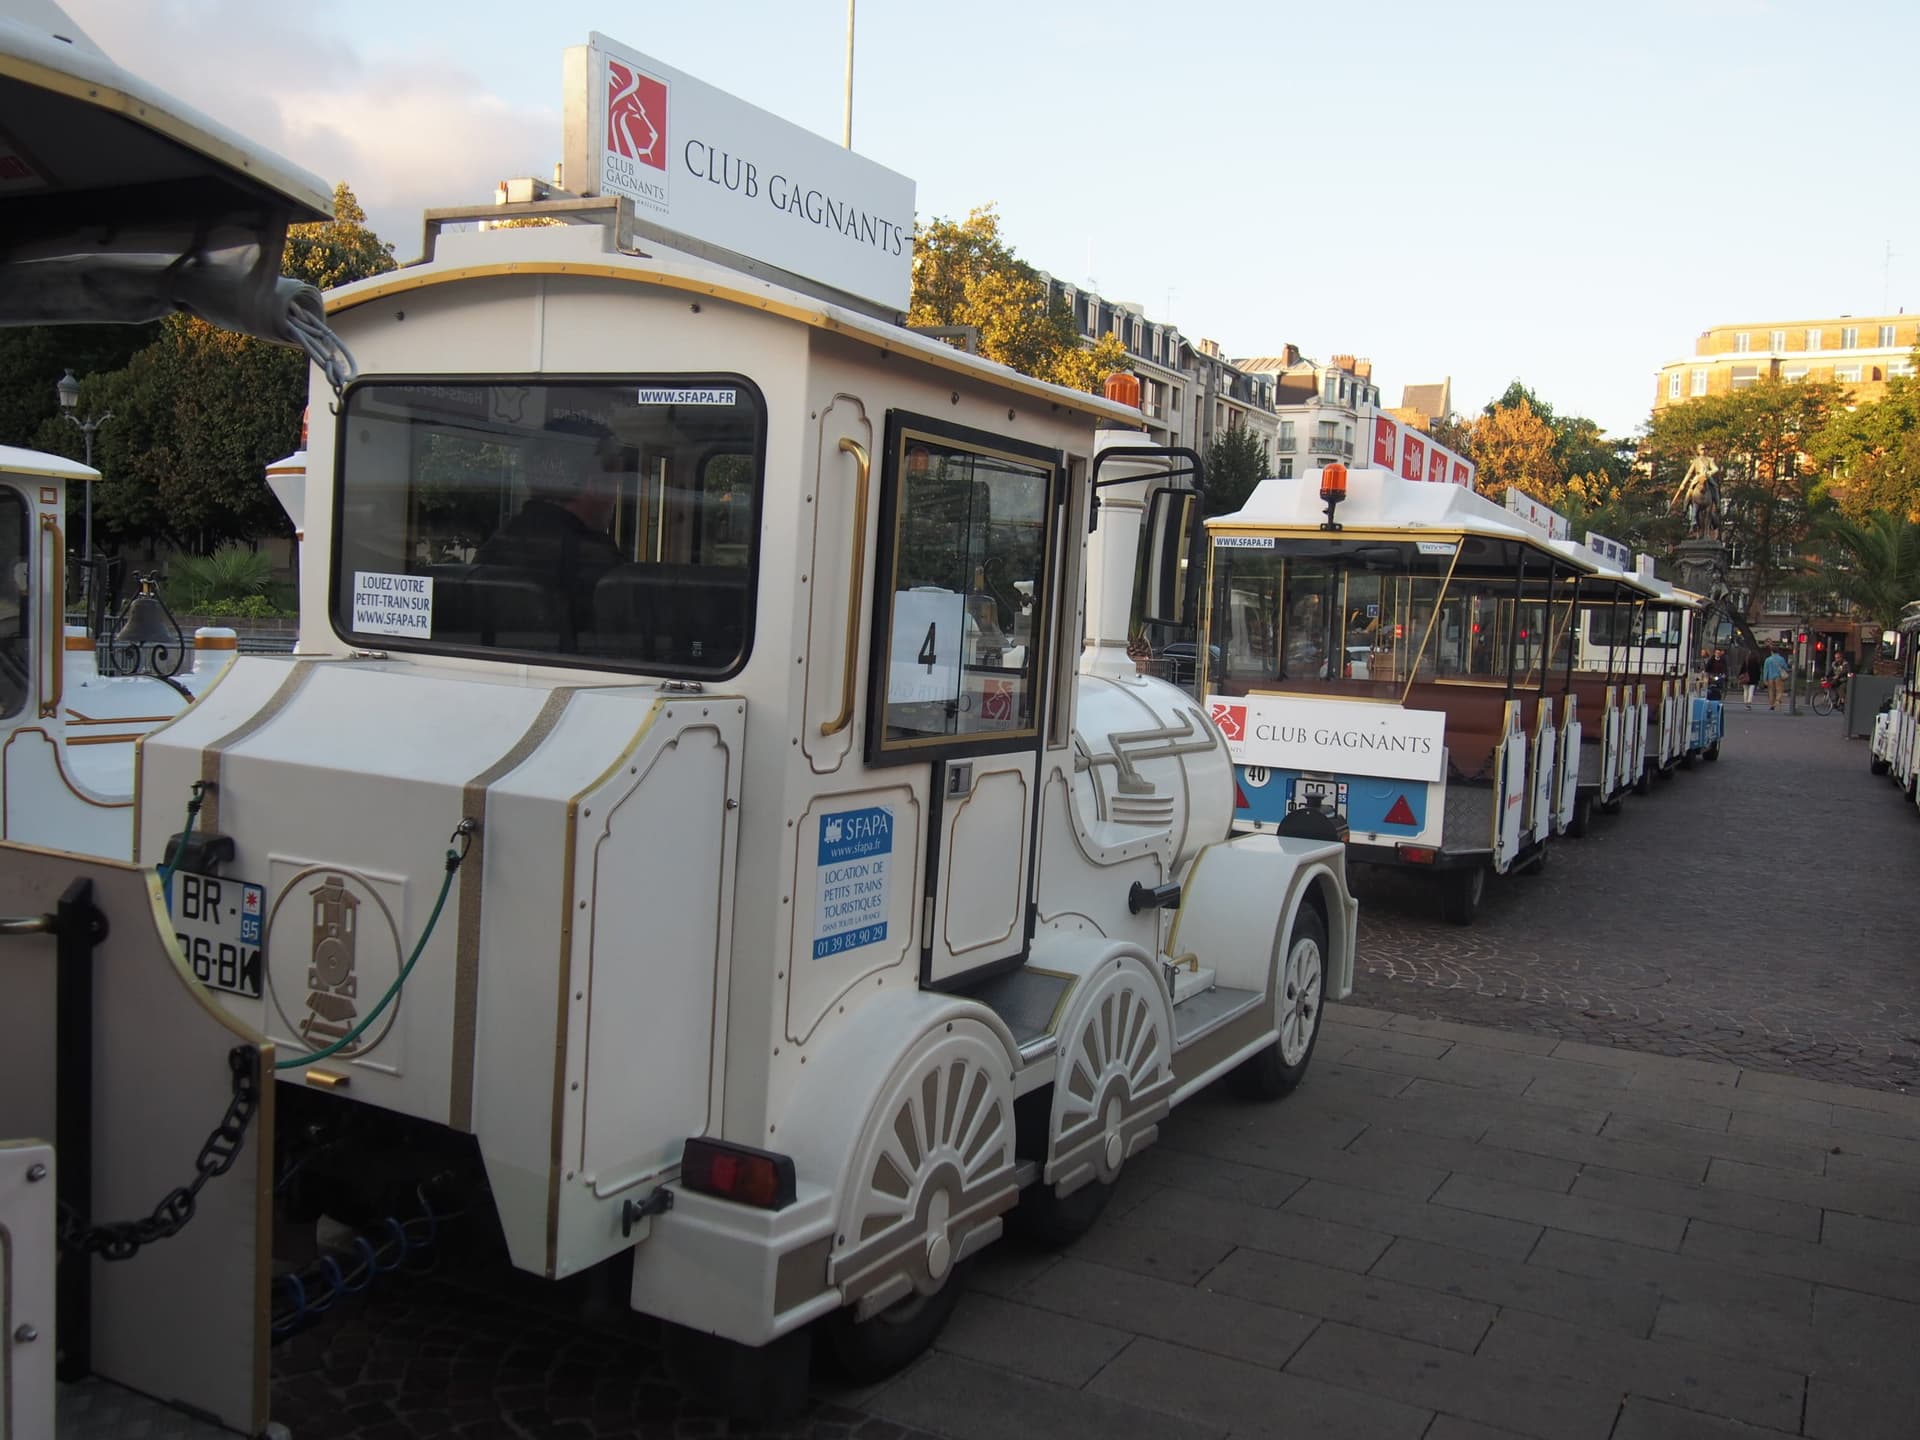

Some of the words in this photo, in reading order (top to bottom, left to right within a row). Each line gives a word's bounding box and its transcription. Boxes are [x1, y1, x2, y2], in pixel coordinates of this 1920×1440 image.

[606, 155, 634, 176] CLUB
[606, 168, 665, 200] GAGNANTS
[685, 139, 759, 199] CLUB
[768, 174, 903, 257] GAGNANTS
[640, 391, 735, 404] WWW.SFAPA.FR
[1215, 537, 1273, 547] WWW.SFAPA.FR
[362, 575, 393, 591] LOUEZ
[394, 578, 425, 593] VOTRE
[356, 592, 410, 609] PETIT-TRAIN
[411, 597, 430, 612] SUR
[356, 609, 428, 629] WWW.SFAPA.FR
[917, 621, 937, 675] 4
[1256, 724, 1308, 744] CLUB
[1314, 729, 1432, 754] GAGNANTS
[1248, 766, 1266, 782] 40
[846, 813, 889, 841] SFAPA
[831, 838, 881, 857] www.sfapa.fr
[825, 864, 870, 885] LOCATION
[873, 861, 884, 874] DE
[824, 885, 850, 902] PETITS
[854, 878, 883, 896] TRAINS
[824, 895, 882, 919] TOURISTIQUES
[242, 919, 259, 940] 95
[817, 941, 829, 956] 01
[831, 937, 842, 952] 39
[845, 933, 857, 948] 82
[859, 929, 870, 943] 90
[873, 926, 883, 940] 29
